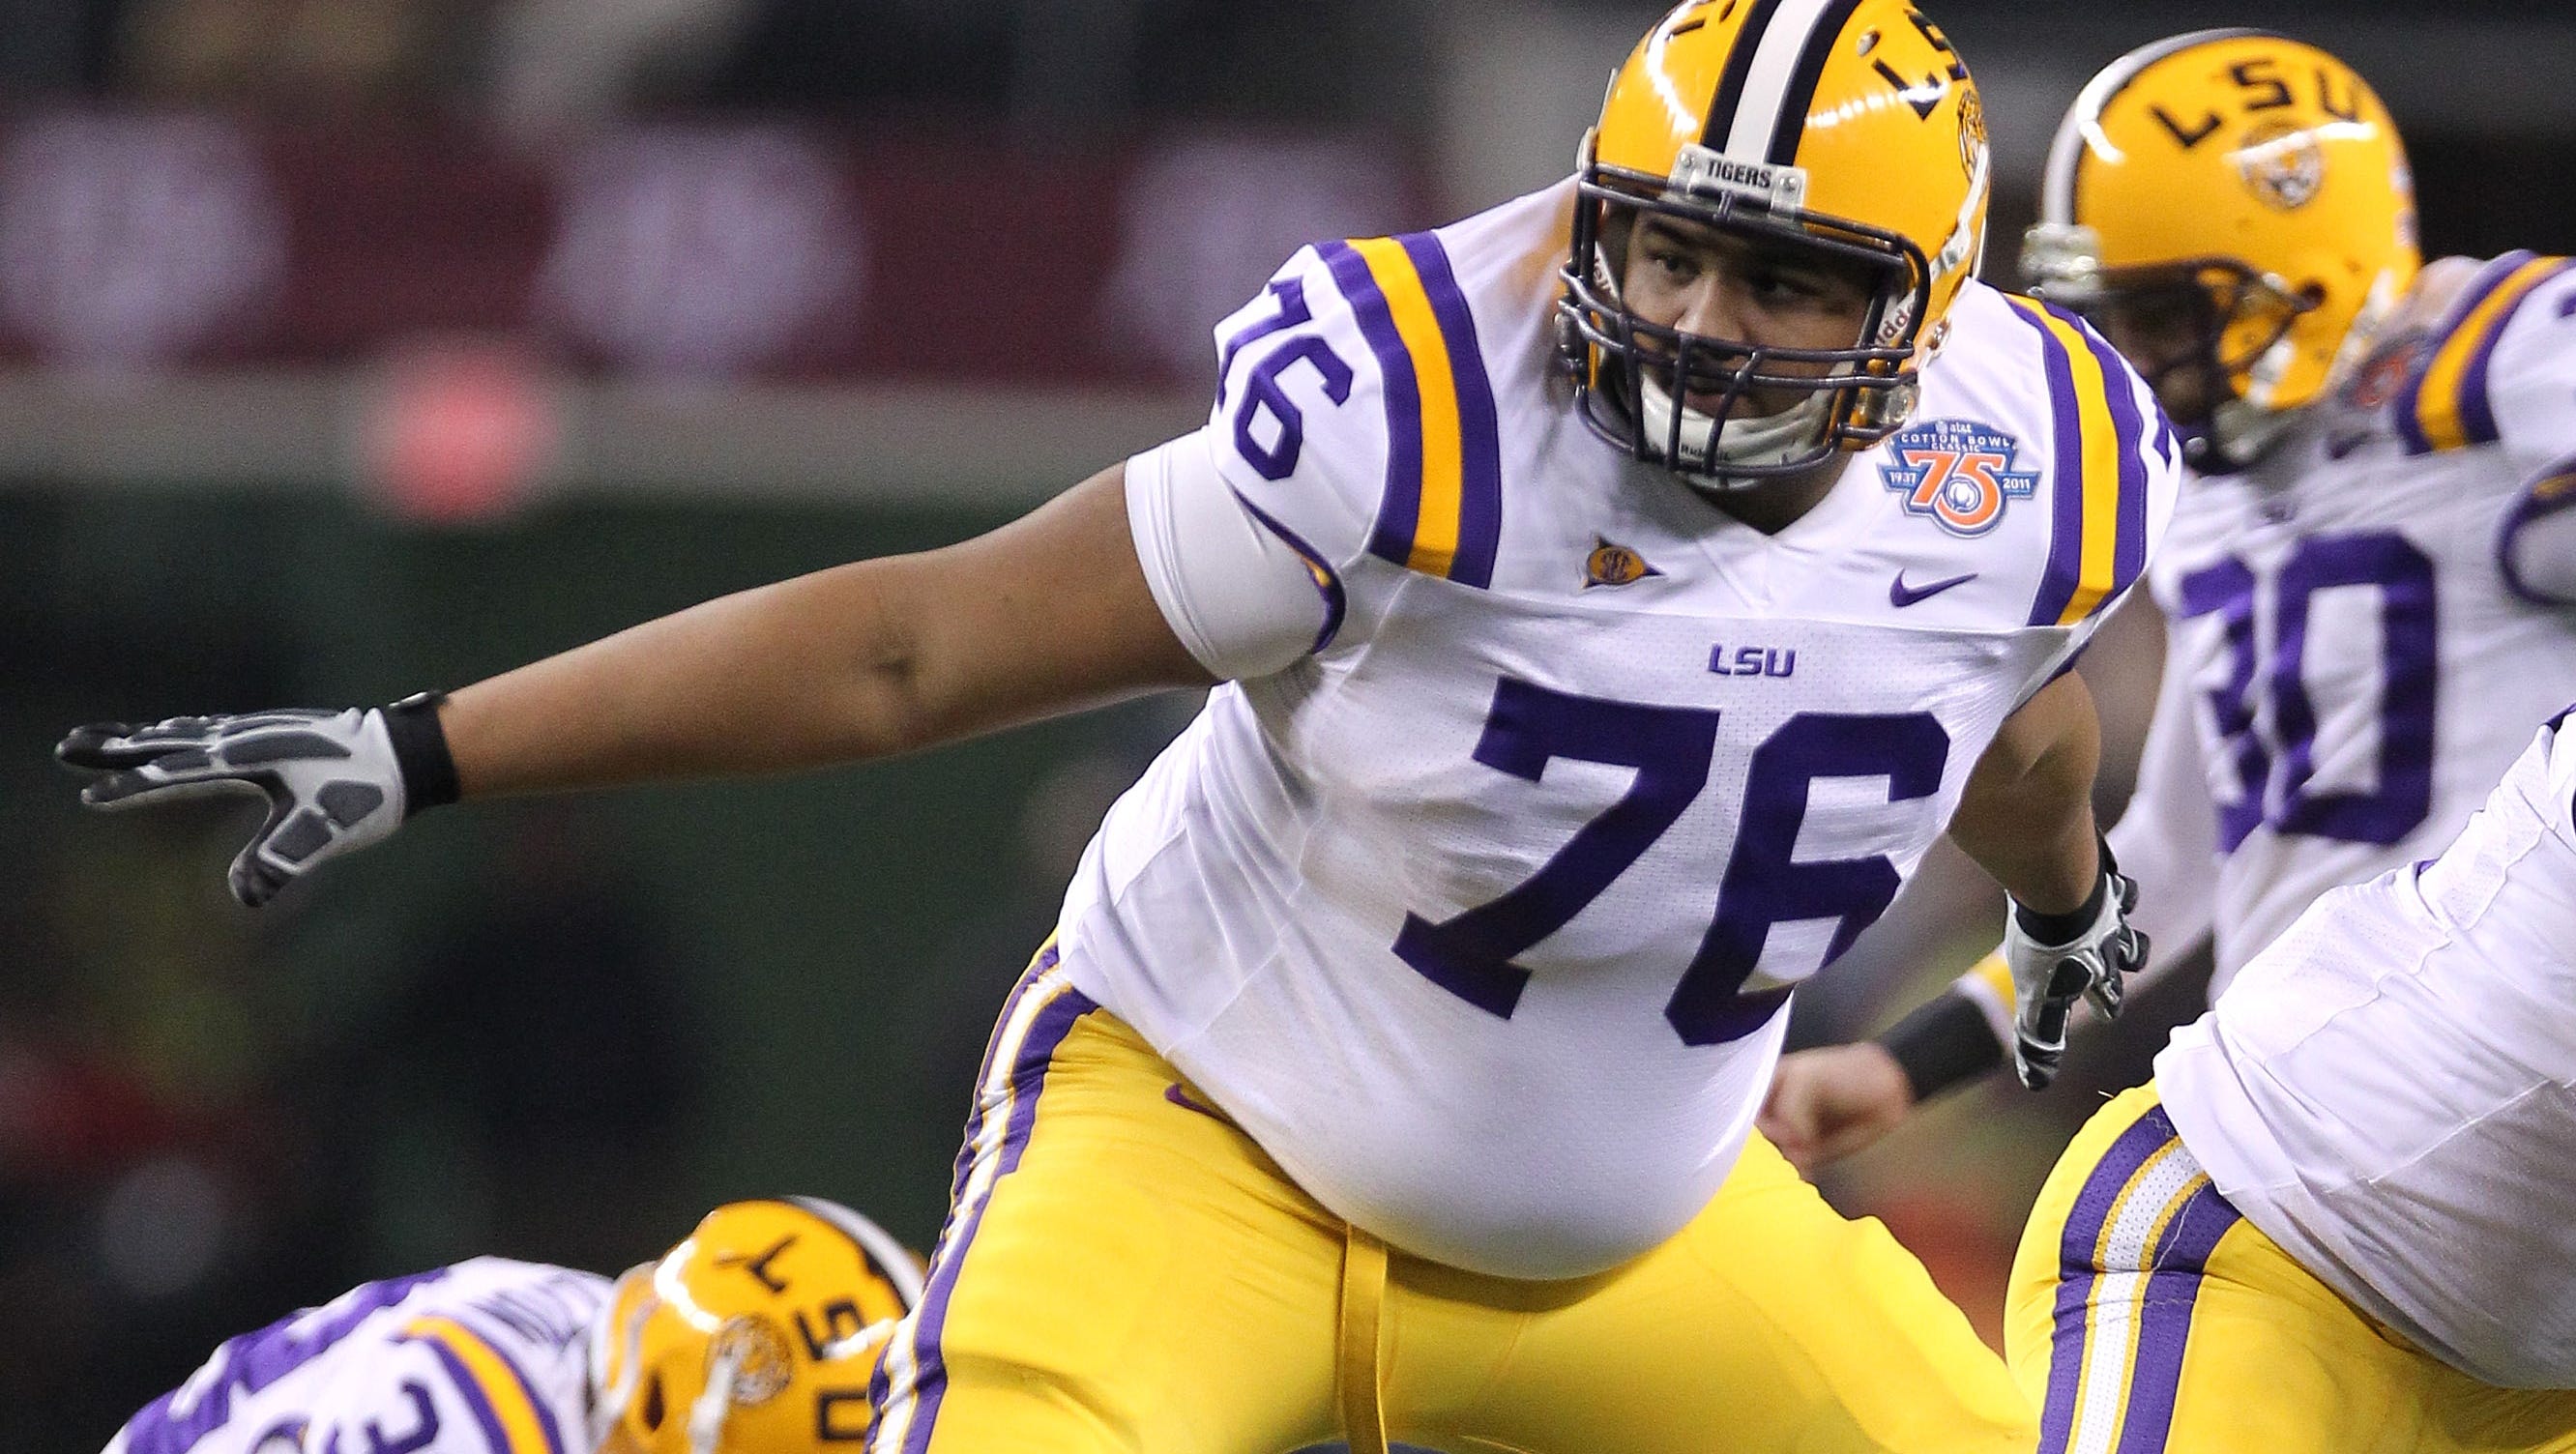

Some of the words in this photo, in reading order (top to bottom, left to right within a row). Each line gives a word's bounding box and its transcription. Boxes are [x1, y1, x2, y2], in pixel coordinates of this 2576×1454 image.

[1870, 8, 1970, 123] LS
[2149, 56, 2358, 148] LSU
[1707, 158, 1772, 189] TIGERS
[1216, 275, 1353, 480] 76
[1900, 432, 1959, 446] COTTON
[1967, 434, 2010, 447] BOWL
[1930, 442, 1981, 452] CLASSIC
[1888, 471, 1917, 484] 1937
[1902, 450, 2006, 529] 75
[2002, 477, 2031, 490] 2011
[1707, 641, 1797, 678] LSU
[1390, 675, 1951, 1046] 76
